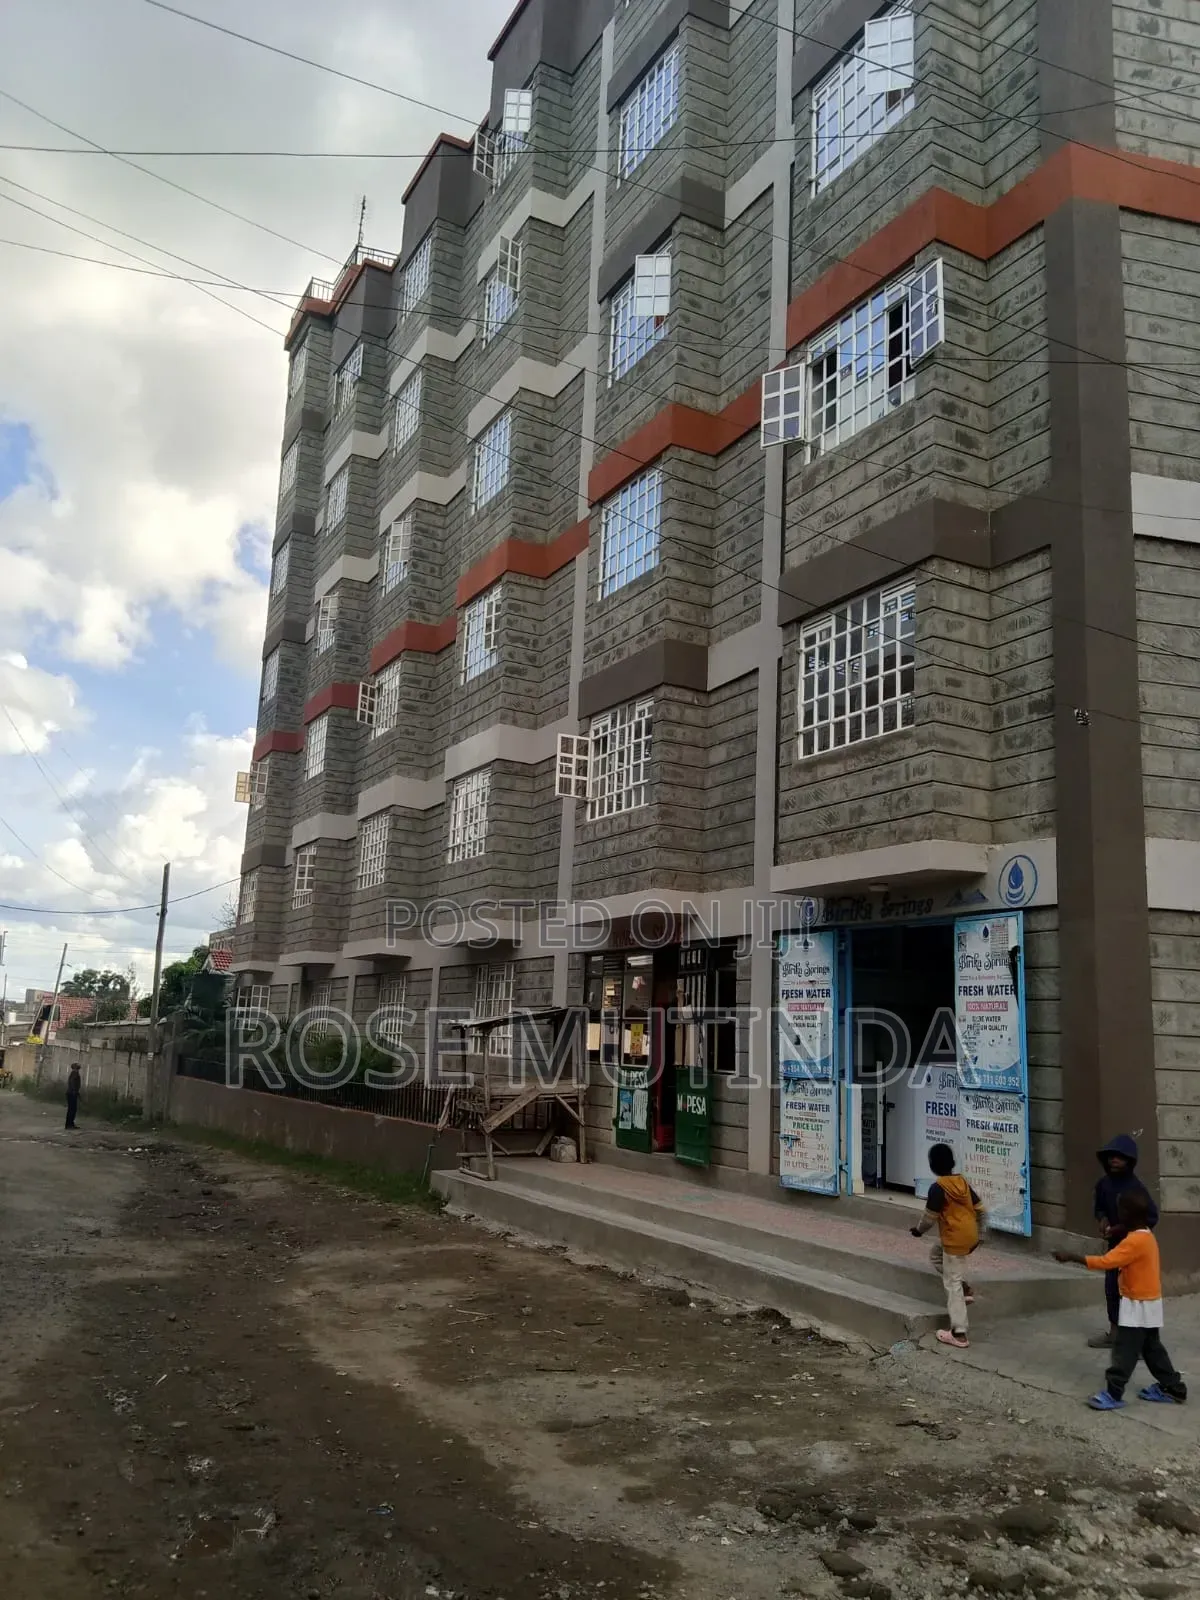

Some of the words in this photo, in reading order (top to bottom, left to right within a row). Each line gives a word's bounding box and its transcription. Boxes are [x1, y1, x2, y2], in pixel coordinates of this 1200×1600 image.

[804, 961, 831, 977] Springs
[781, 989, 804, 999] FRESH
[806, 988, 831, 999] WATER
[958, 985, 984, 996] FRESH
[987, 984, 1015, 996] WATER
[981, 1001, 1007, 1010] NATURAL
[786, 1101, 806, 1111] FRESH
[807, 1103, 830, 1113] WATER
[925, 1101, 957, 1117] FRESH
[793, 1122, 810, 1131] PRICE
[811, 1123, 823, 1132] LIST
[966, 1119, 991, 1131] FRESH
[993, 1122, 1019, 1134] WATER
[975, 1143, 995, 1154] PRICE
[997, 1147, 1011, 1156] LIST
[969, 1153, 988, 1163] LITRE
[971, 1166, 991, 1176] LITRE
